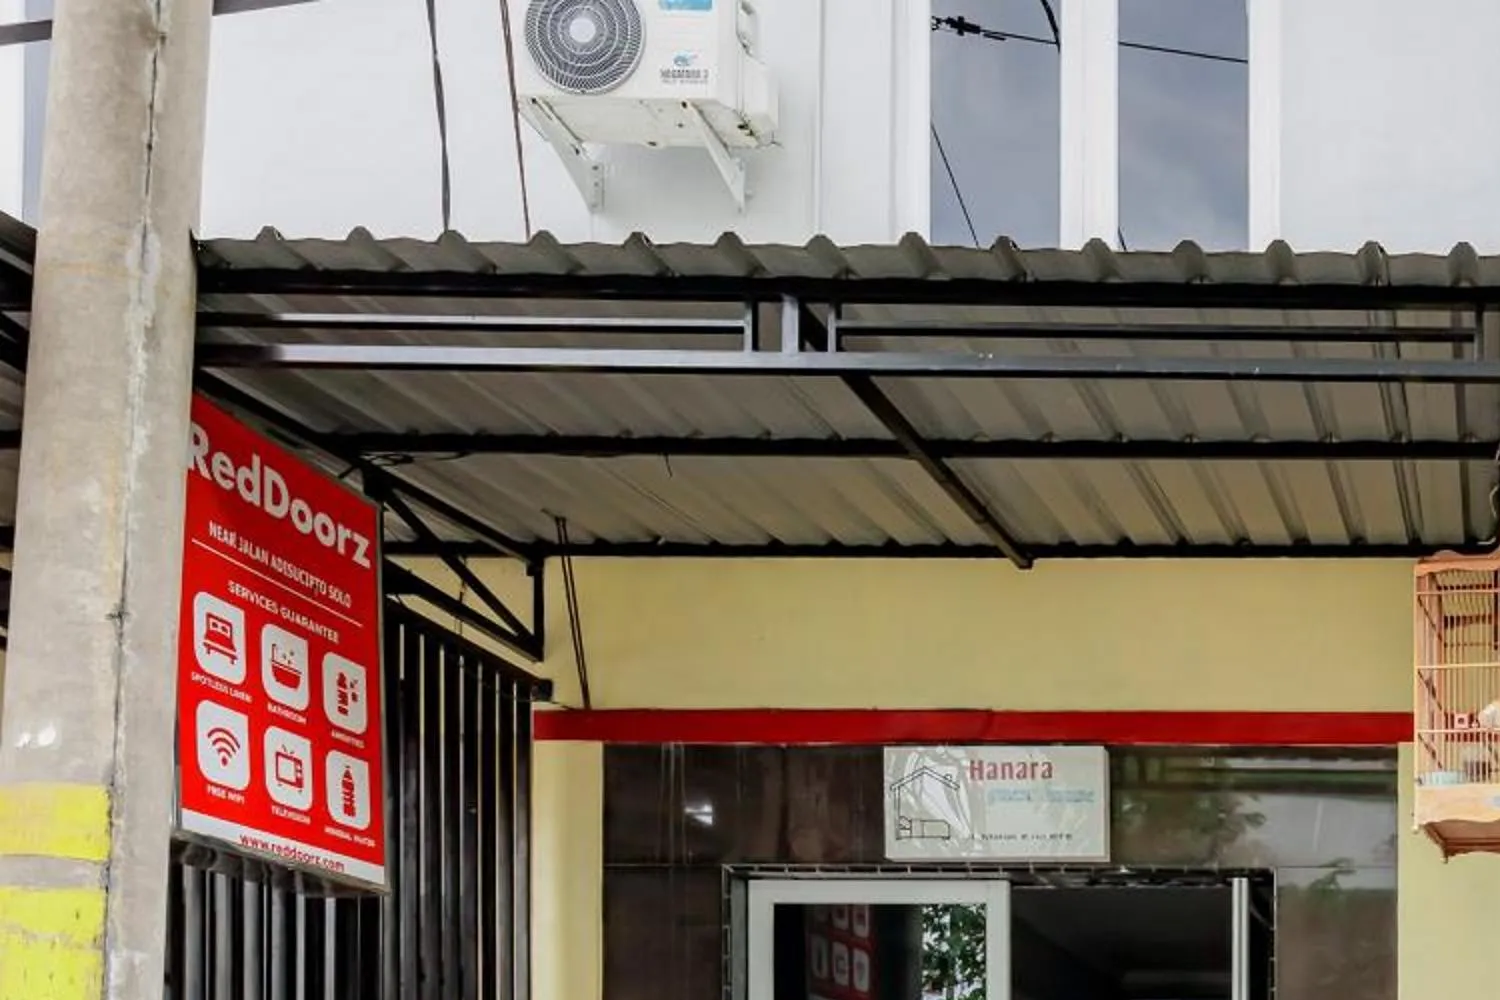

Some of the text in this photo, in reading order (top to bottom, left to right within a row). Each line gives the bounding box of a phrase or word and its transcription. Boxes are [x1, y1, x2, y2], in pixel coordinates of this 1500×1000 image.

[187, 422, 371, 569] RedDoorz
[208, 520, 237, 549] NEAR
[238, 536, 269, 566] JALAN
[328, 585, 351, 608] SOLO
[227, 580, 339, 644] SERVICES GUARANTEE
[970, 760, 1053, 780] Hanara
